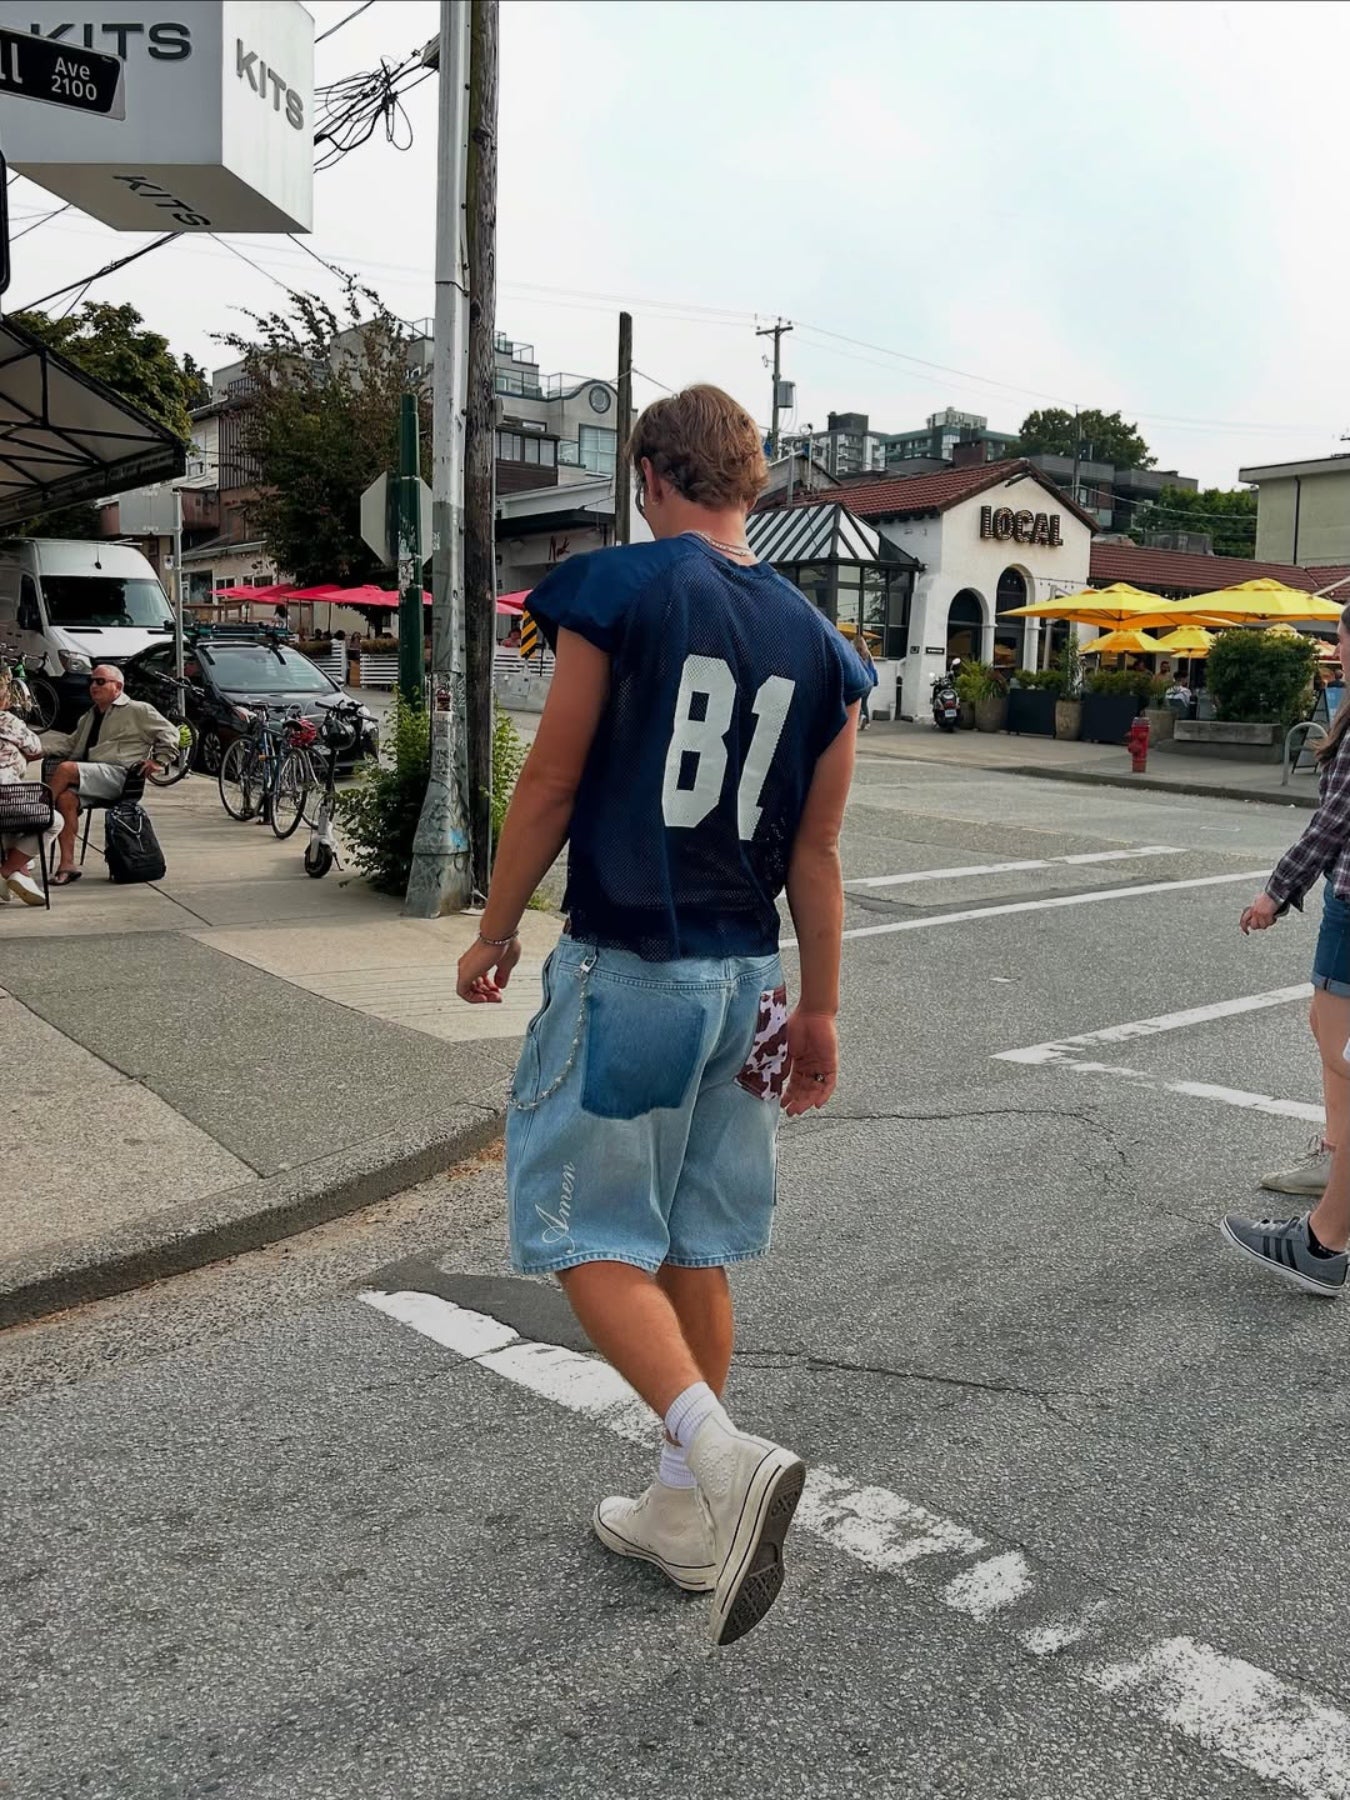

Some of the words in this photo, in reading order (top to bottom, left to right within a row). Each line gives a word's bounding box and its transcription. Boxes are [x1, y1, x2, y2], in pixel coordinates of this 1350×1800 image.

[51, 75, 97, 101] 2100
[55, 57, 91, 80] Ave
[236, 38, 304, 130] KITS
[112, 175, 212, 226] KITS
[980, 505, 1064, 546] LOCAL
[661, 653, 796, 841] 81
[534, 1161, 576, 1255] Amen
